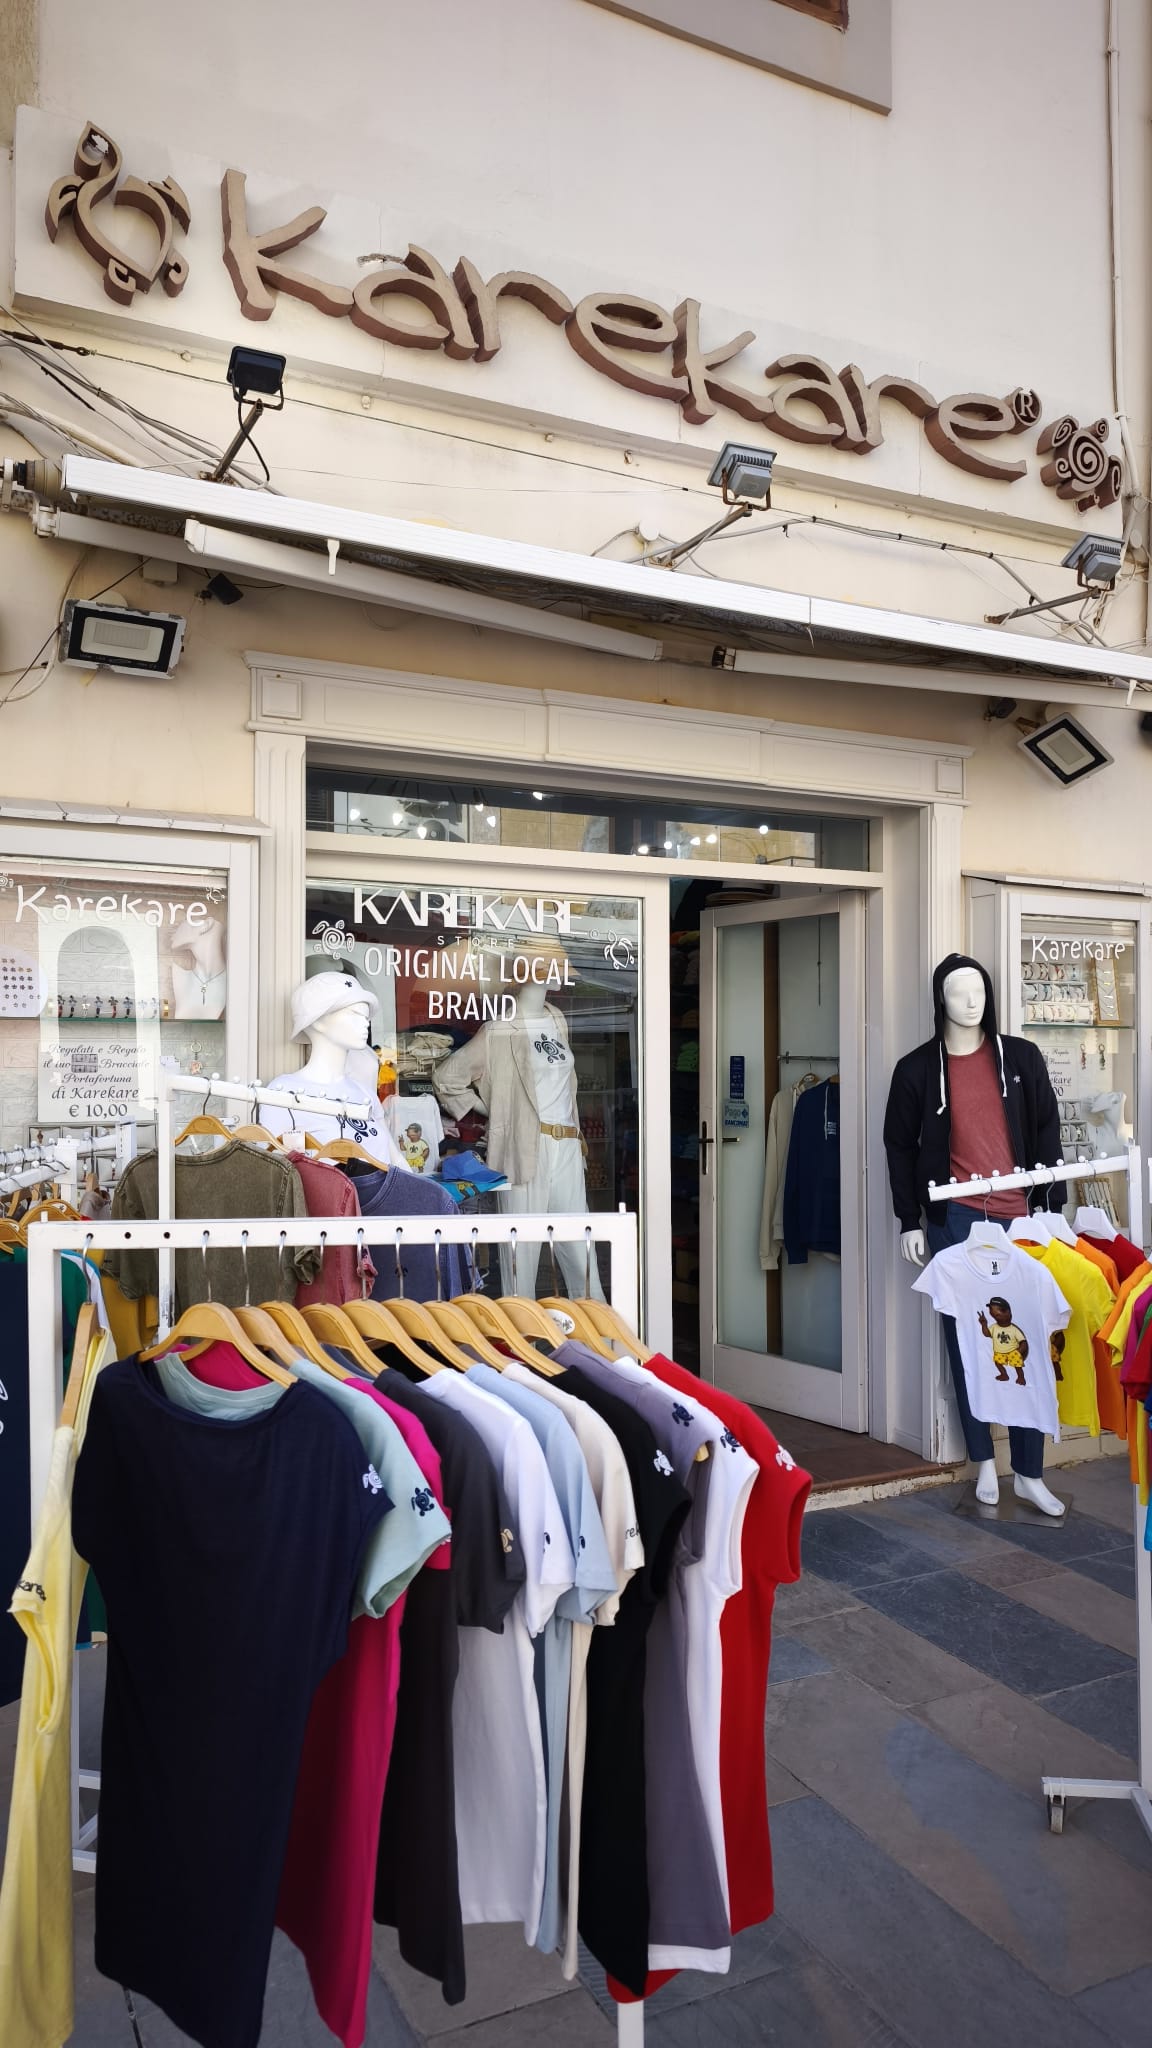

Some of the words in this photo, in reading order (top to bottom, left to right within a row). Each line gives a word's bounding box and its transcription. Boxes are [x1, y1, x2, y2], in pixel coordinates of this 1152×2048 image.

[15, 885, 208, 928] Karekare
[354, 886, 589, 936] KAREKARE
[437, 935, 514, 949] STORE
[1031, 936, 1126, 962] Karekare
[364, 947, 491, 982] ORIGINAL
[500, 954, 576, 987] LOCAL
[428, 990, 517, 1023] BRAND
[51, 1086, 66, 1099] di
[69, 1086, 139, 1099] Karekare
[69, 1104, 80, 1118] €
[86, 1103, 128, 1118] 10,00
